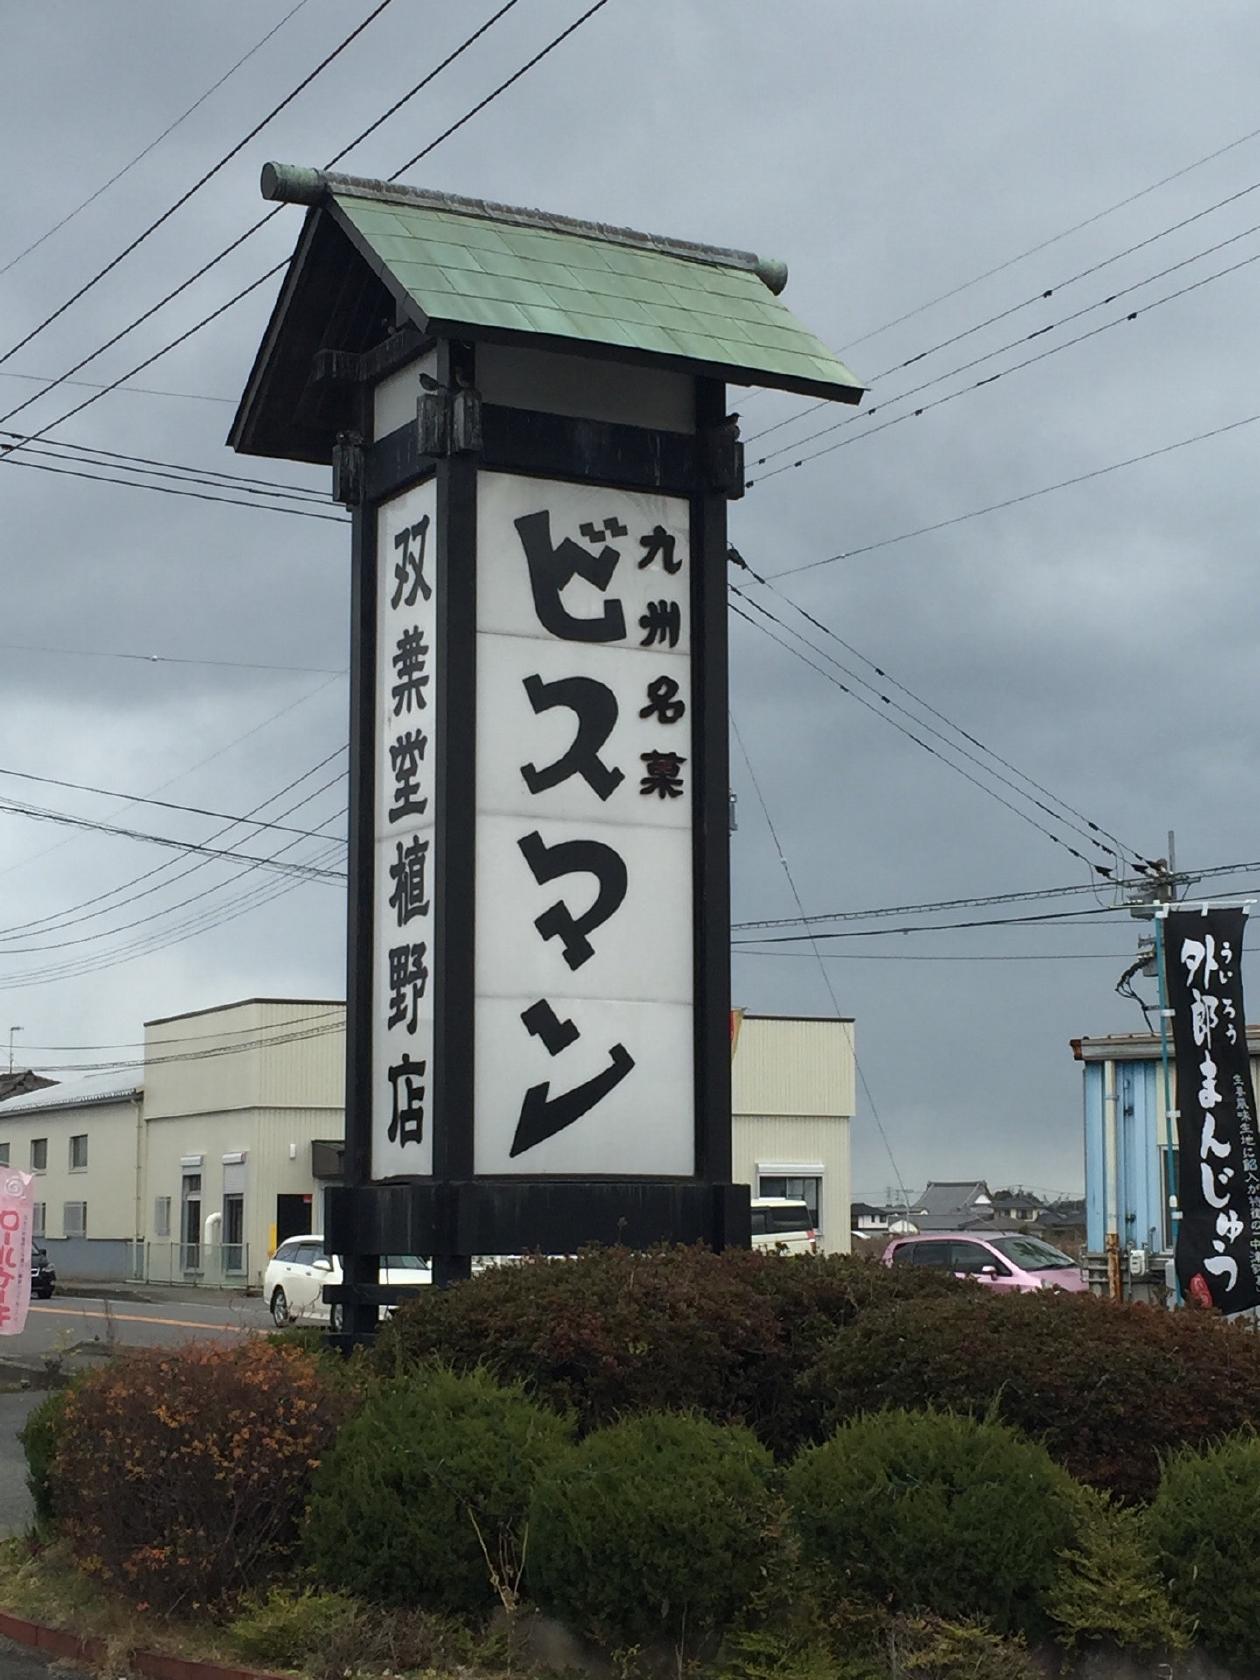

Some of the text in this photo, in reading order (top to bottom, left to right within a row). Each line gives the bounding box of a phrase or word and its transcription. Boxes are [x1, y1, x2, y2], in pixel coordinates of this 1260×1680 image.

[388, 513, 432, 1149] 双葉堂植野店
[509, 509, 635, 1159] ビスマン
[638, 525, 687, 800] 九州名菓
[1181, 934, 1244, 1292] 外郎まんじゅう
[1219, 941, 1238, 1045] ういろう
